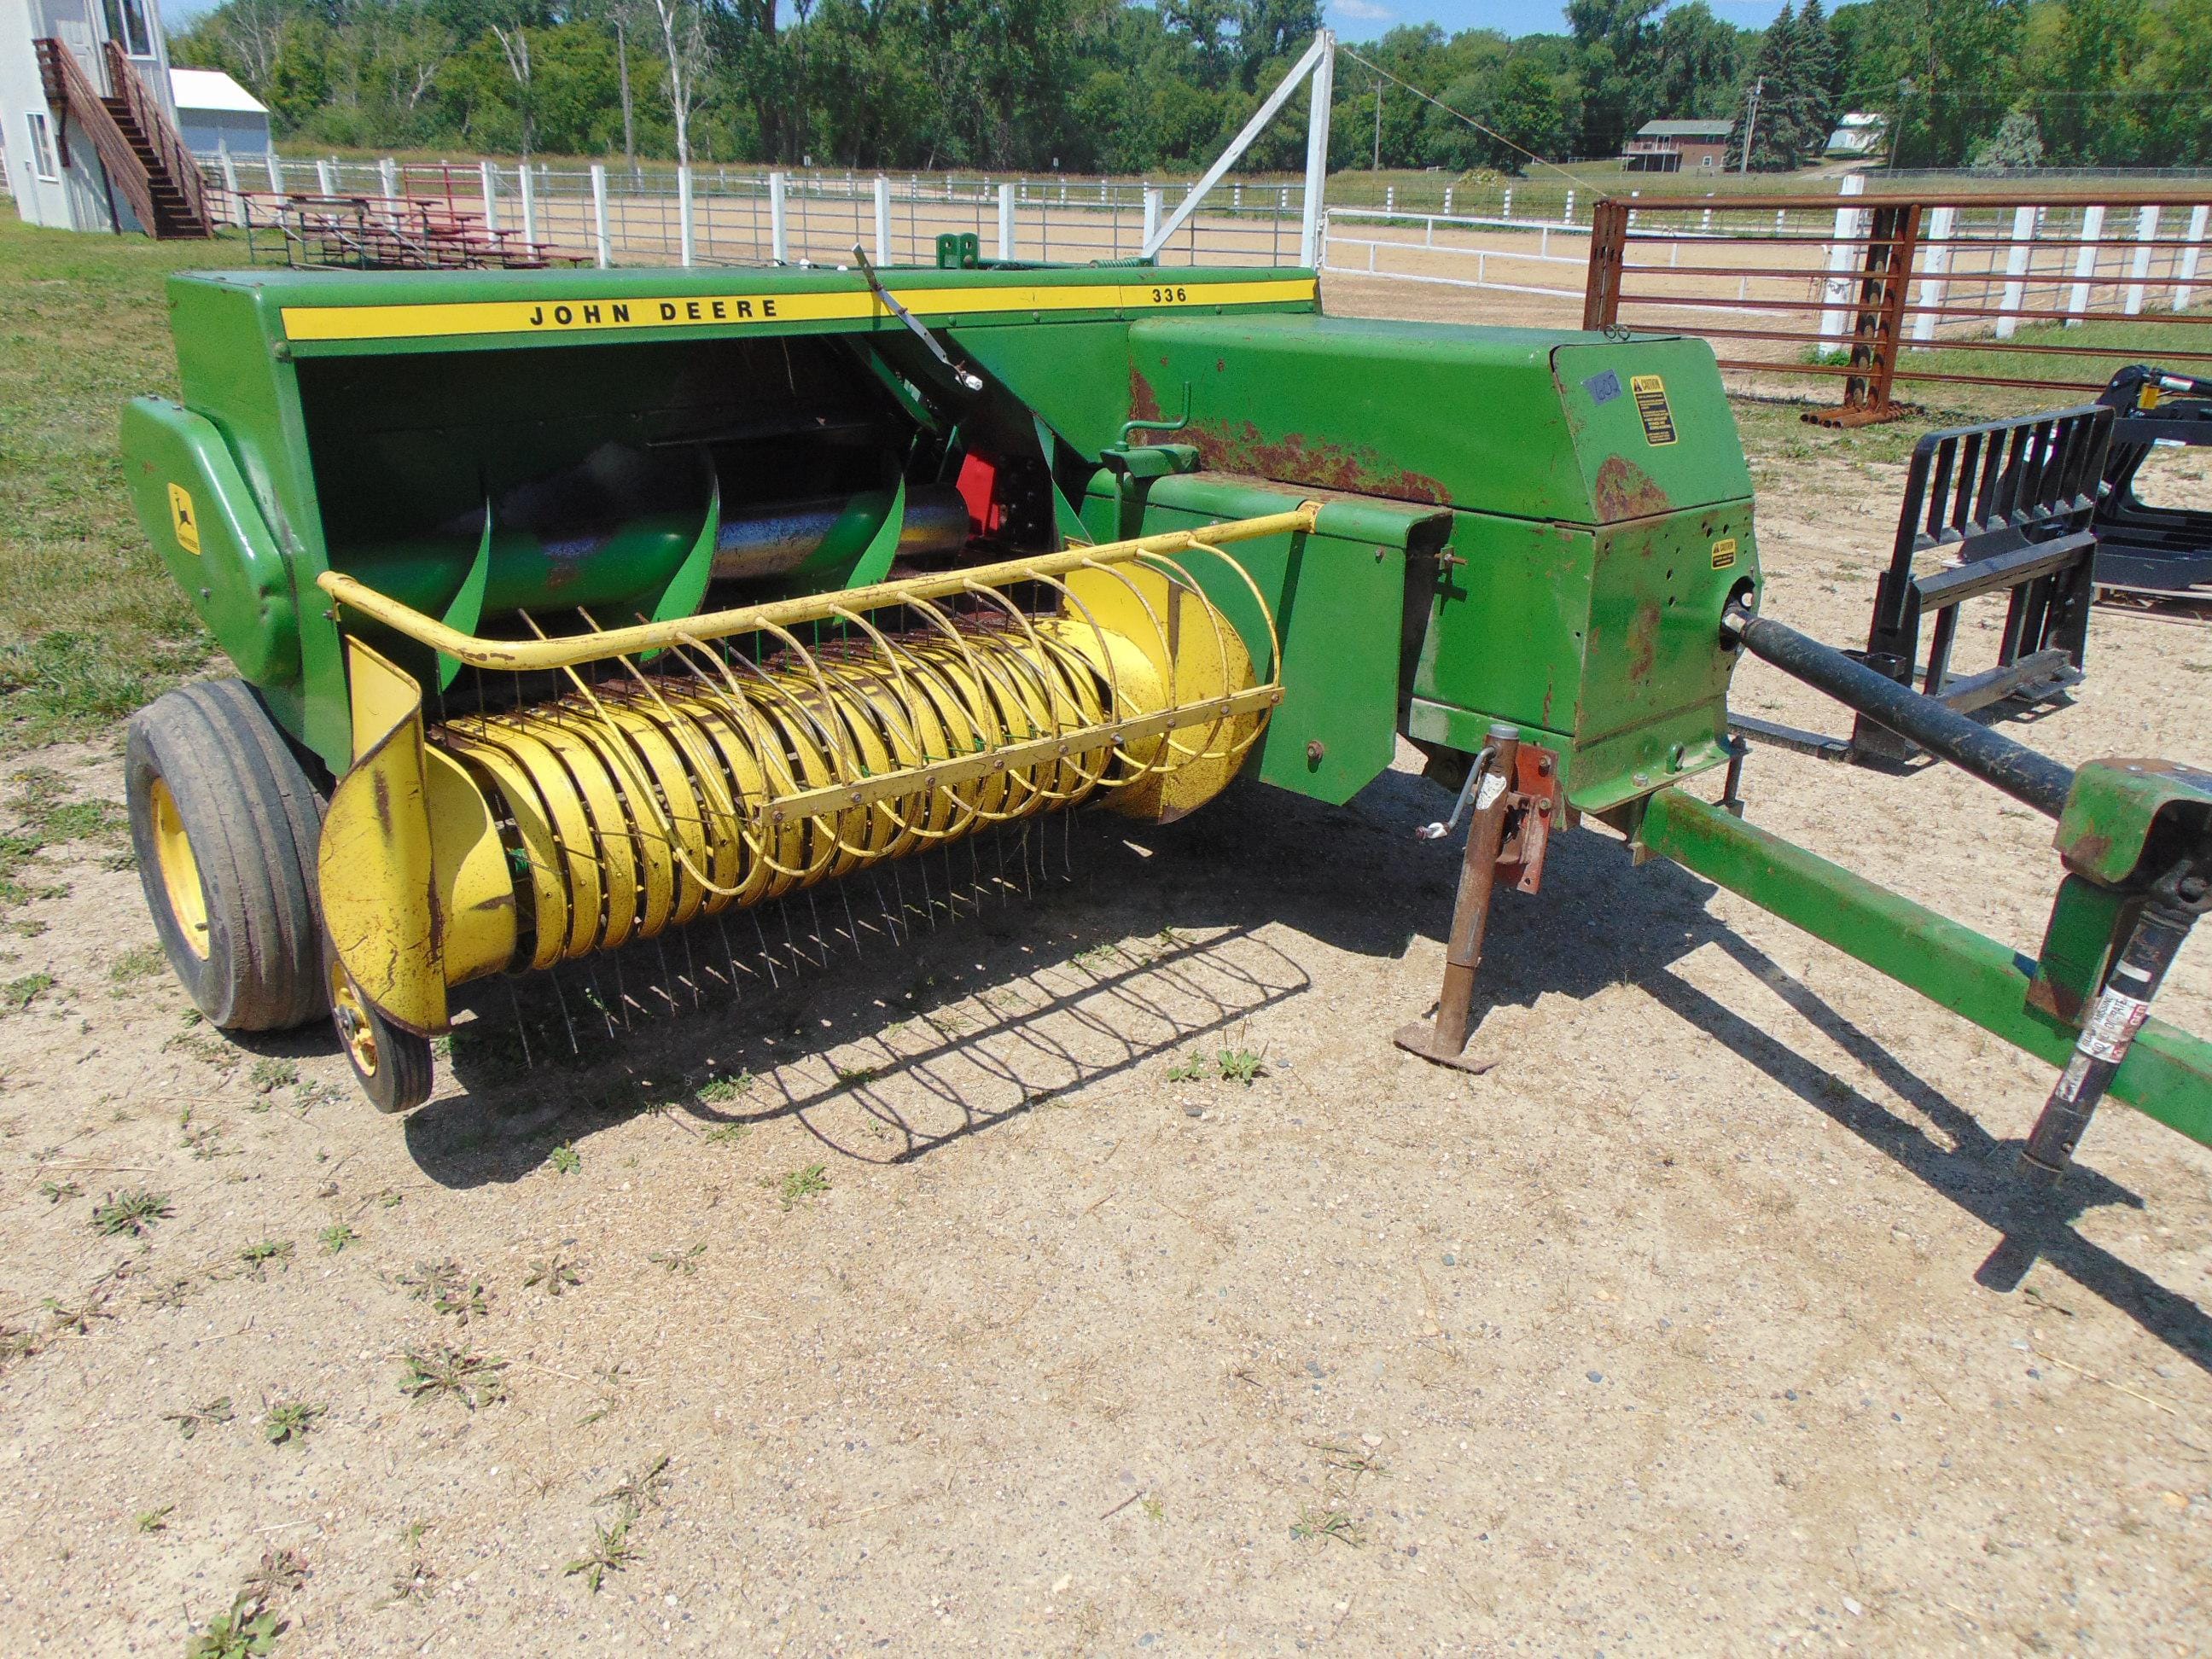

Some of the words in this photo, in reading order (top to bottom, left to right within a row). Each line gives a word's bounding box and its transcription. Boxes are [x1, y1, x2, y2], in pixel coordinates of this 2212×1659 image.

[1152, 288, 1186, 303] 336
[530, 304, 630, 326] JOHN
[659, 300, 777, 321] DEERE
